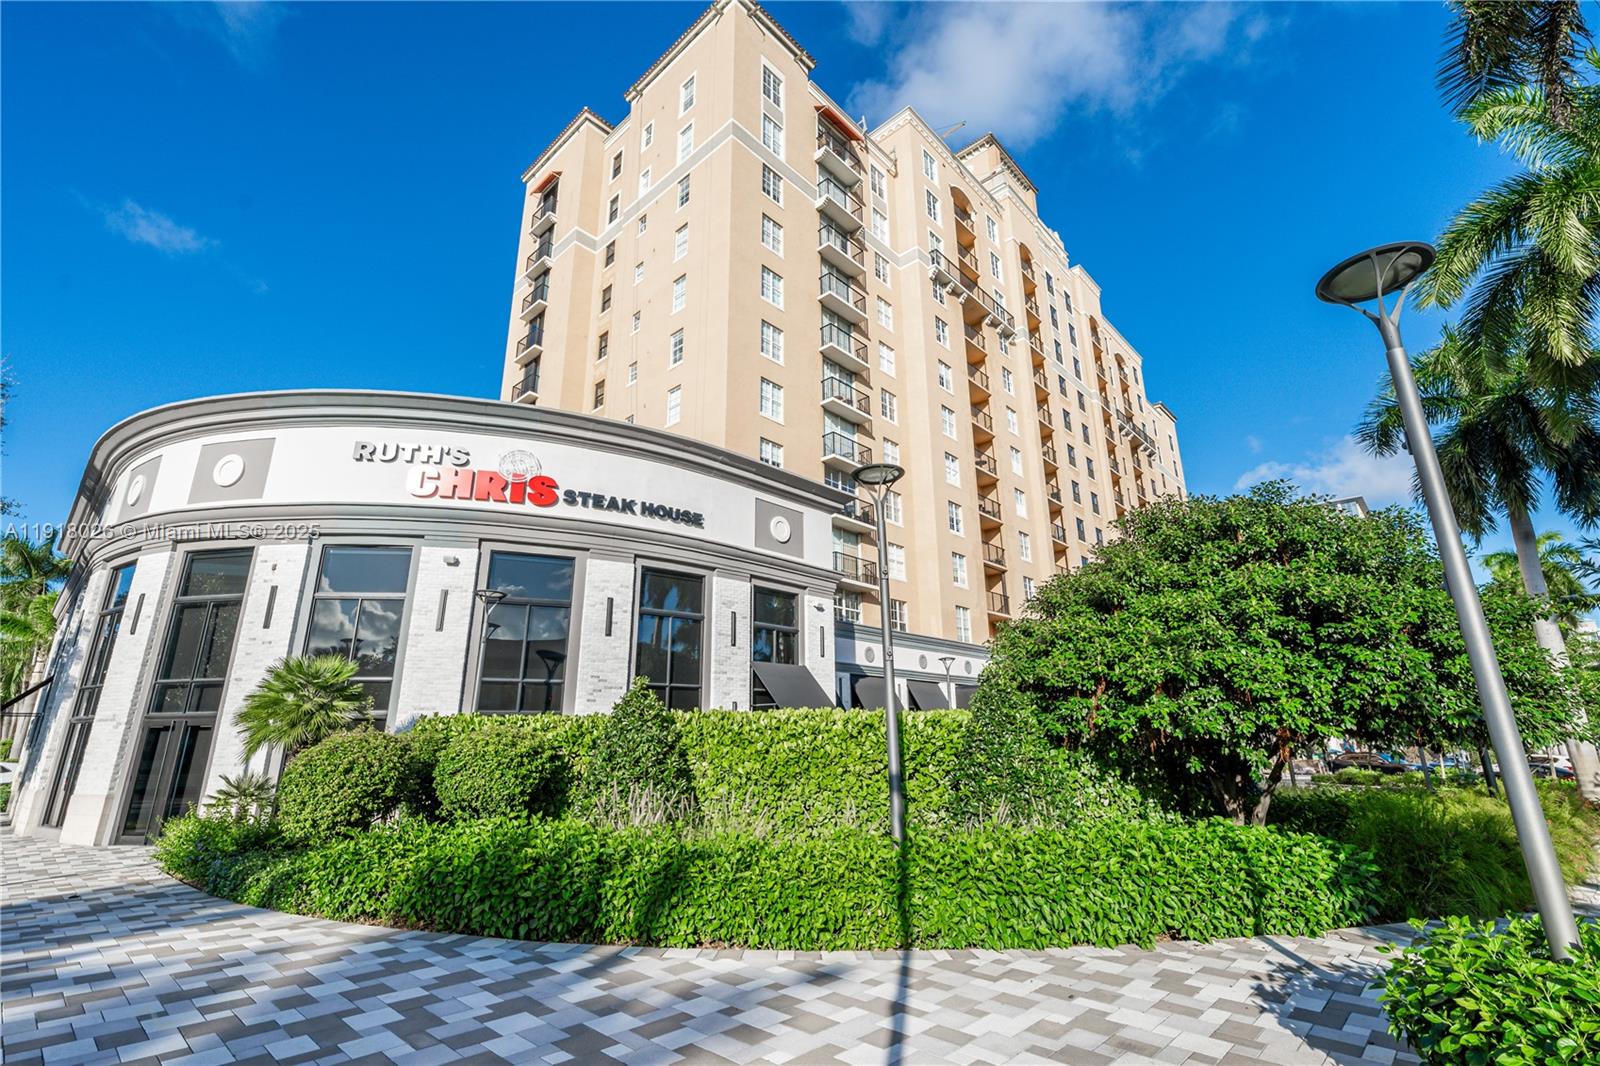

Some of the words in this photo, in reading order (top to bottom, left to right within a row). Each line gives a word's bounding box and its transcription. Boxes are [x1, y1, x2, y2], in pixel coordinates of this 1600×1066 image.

[353, 440, 471, 467] RUTH'S
[562, 489, 636, 515] STEAK
[640, 501, 705, 530] HOUSE
